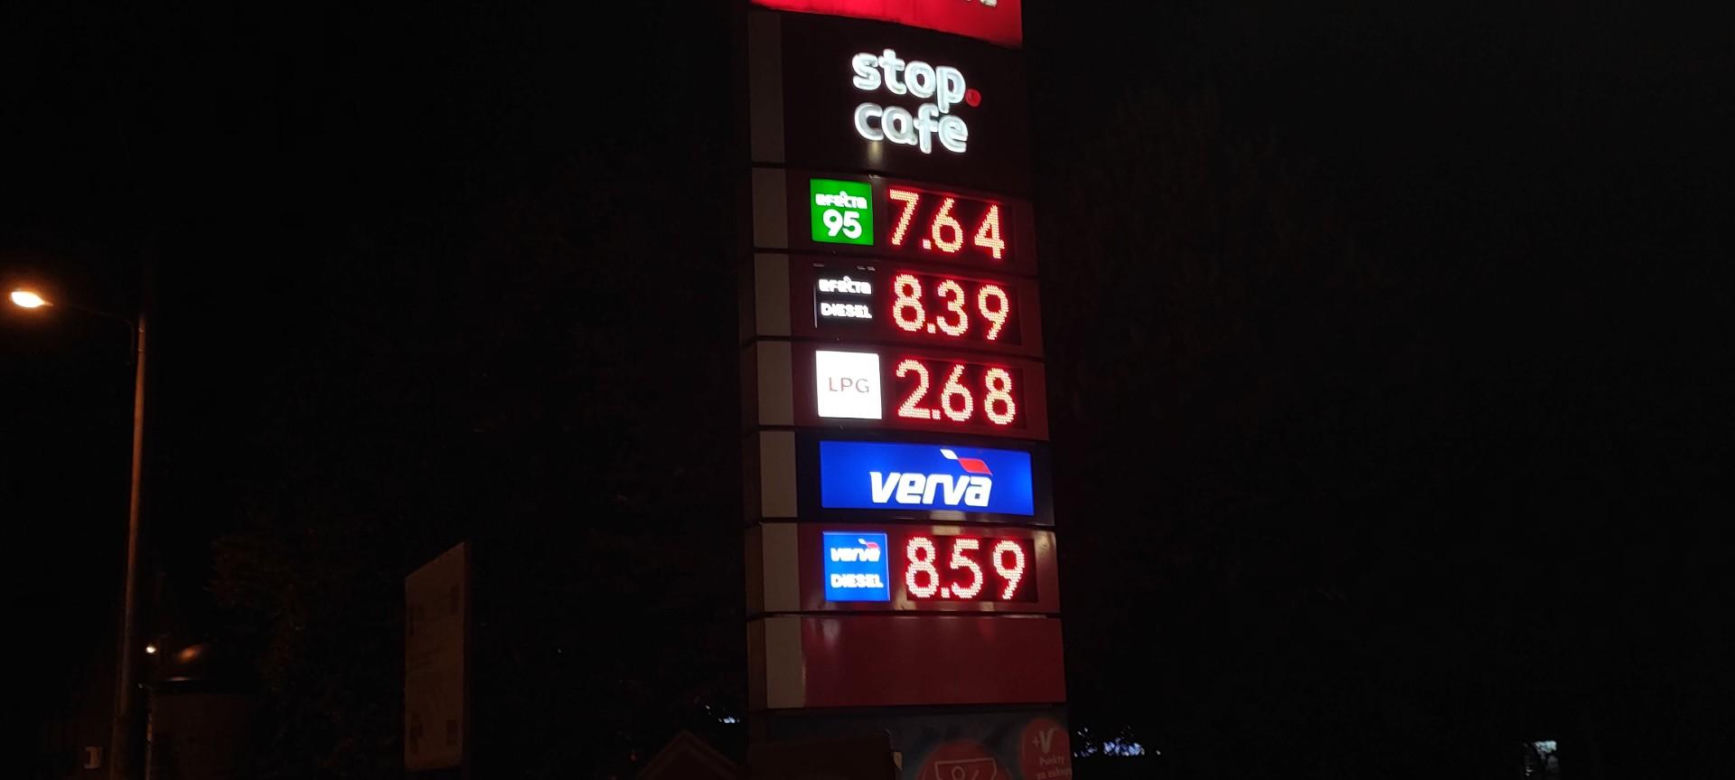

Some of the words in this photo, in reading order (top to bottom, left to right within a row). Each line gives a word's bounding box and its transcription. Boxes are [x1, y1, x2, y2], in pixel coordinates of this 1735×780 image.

[852, 49, 981, 113] stop.
[855, 103, 968, 154] cafe
[823, 209, 862, 239] 95
[889, 188, 1006, 260] 7.64
[820, 302, 873, 319] DIESEL
[892, 273, 1010, 341] 8.39
[828, 377, 870, 394] LPG
[895, 359, 1016, 426] 2.68
[870, 471, 992, 507] verva
[830, 573, 884, 588] DIESEL
[905, 537, 1026, 601] 8.59
